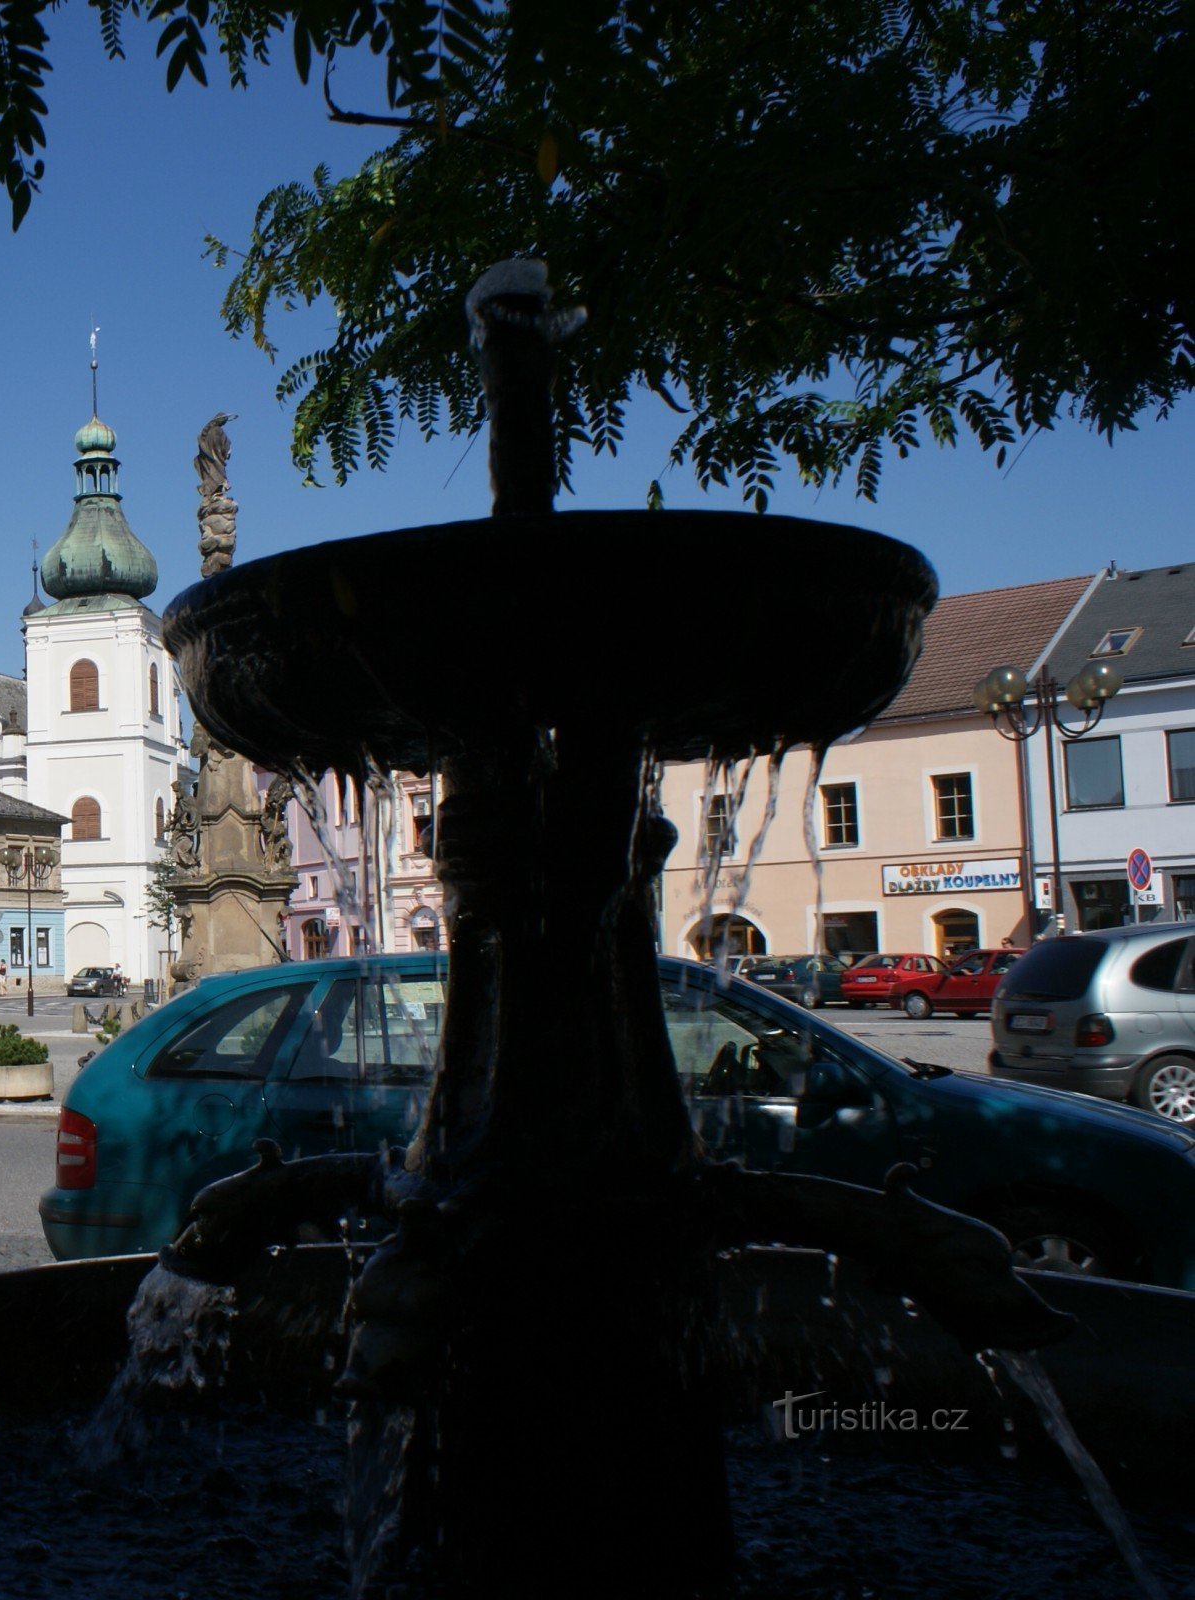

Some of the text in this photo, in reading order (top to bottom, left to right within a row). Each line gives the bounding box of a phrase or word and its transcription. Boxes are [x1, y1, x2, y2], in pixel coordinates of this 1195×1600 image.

[899, 862, 964, 877] OBKLADY
[888, 873, 1020, 893] DLAŽBY KOUPELNY
